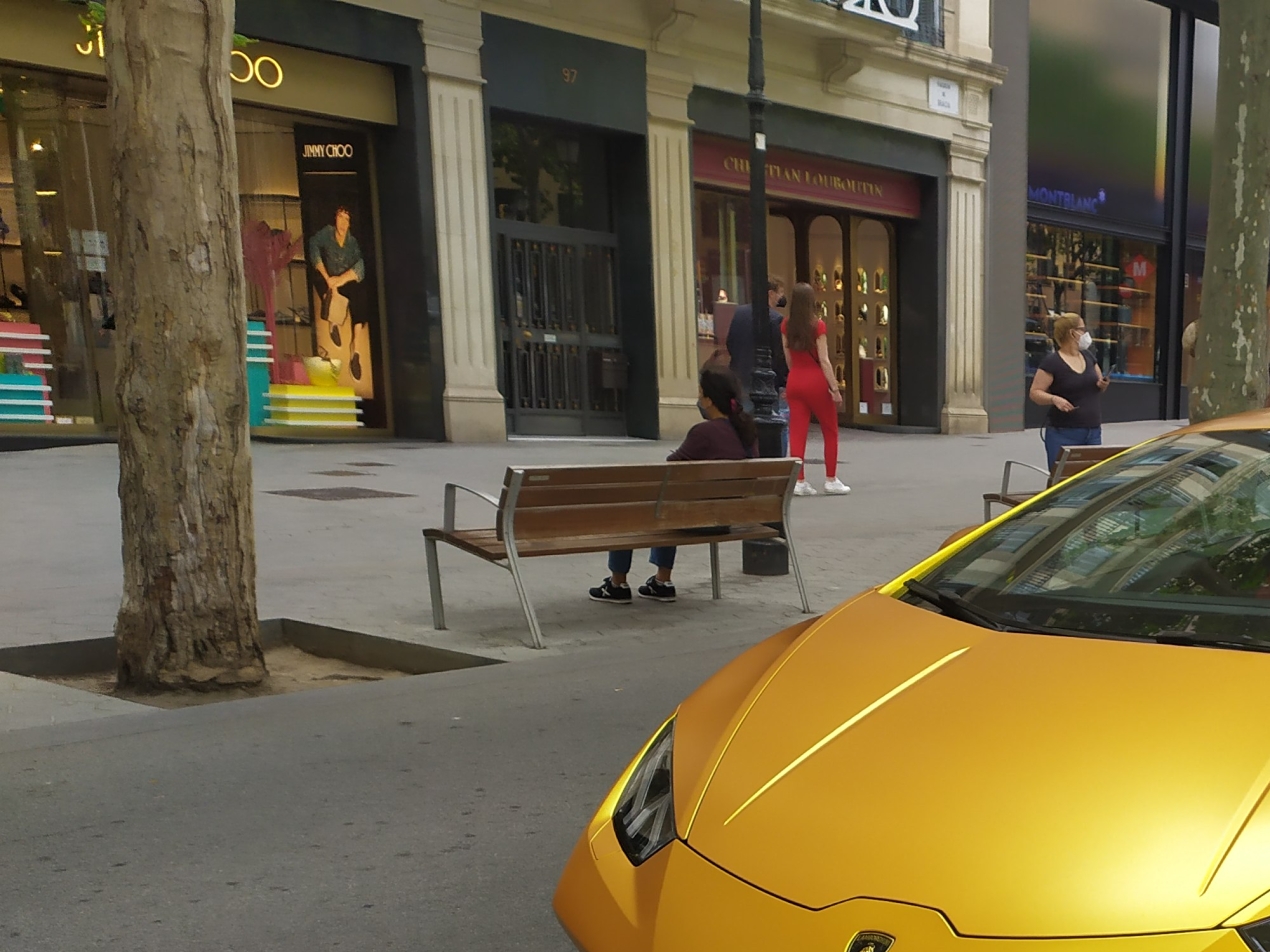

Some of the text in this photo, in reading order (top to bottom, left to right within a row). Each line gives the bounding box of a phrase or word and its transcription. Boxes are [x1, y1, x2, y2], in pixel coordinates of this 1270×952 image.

[562, 68, 578, 83] 97
[302, 144, 353, 157] JIMMY CHOO
[804, 170, 884, 198] LOUBOUTIN
[1027, 184, 1098, 214] MONTBLANC
